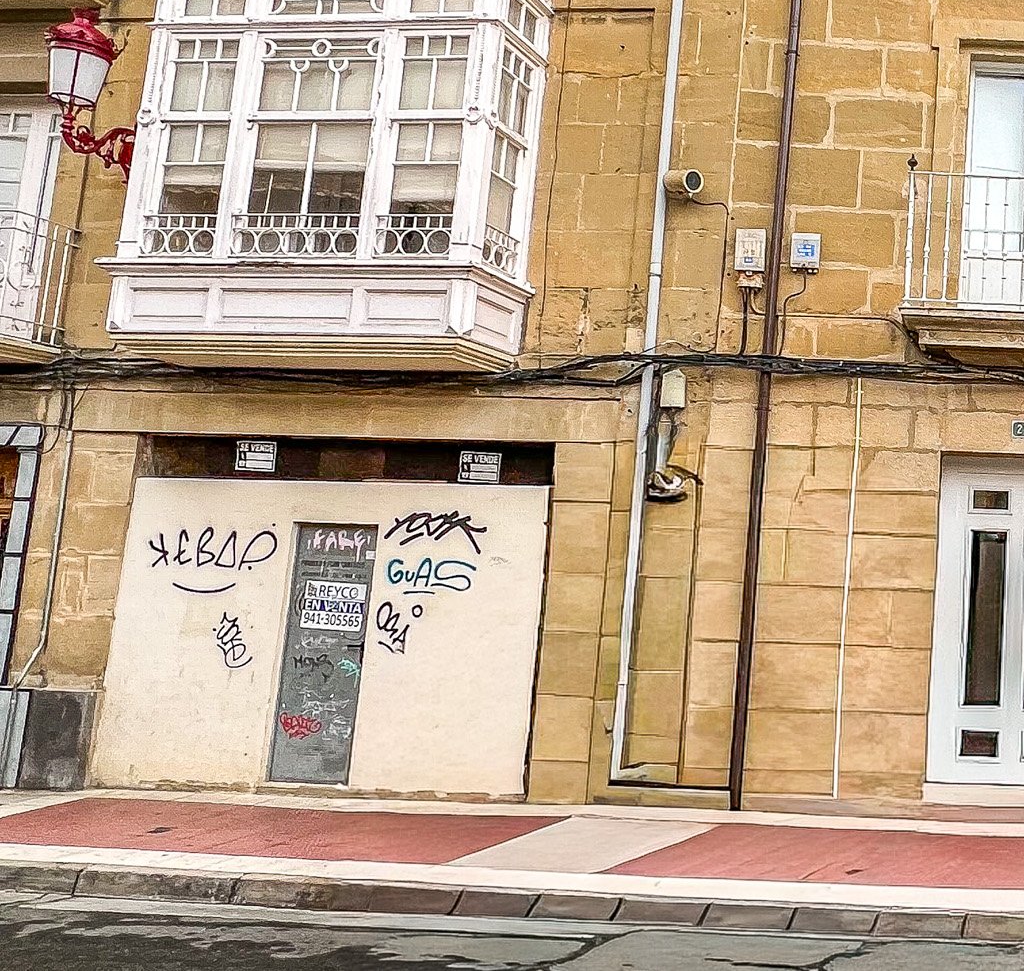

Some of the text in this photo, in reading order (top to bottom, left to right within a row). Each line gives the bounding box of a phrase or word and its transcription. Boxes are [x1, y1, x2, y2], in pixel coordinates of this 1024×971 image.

[239, 443, 249, 452] SE
[462, 454, 499, 464] SE VENDE
[318, 584, 359, 599] REYCO
[304, 599, 321, 611] EN
[303, 611, 360, 628] 941-305565
